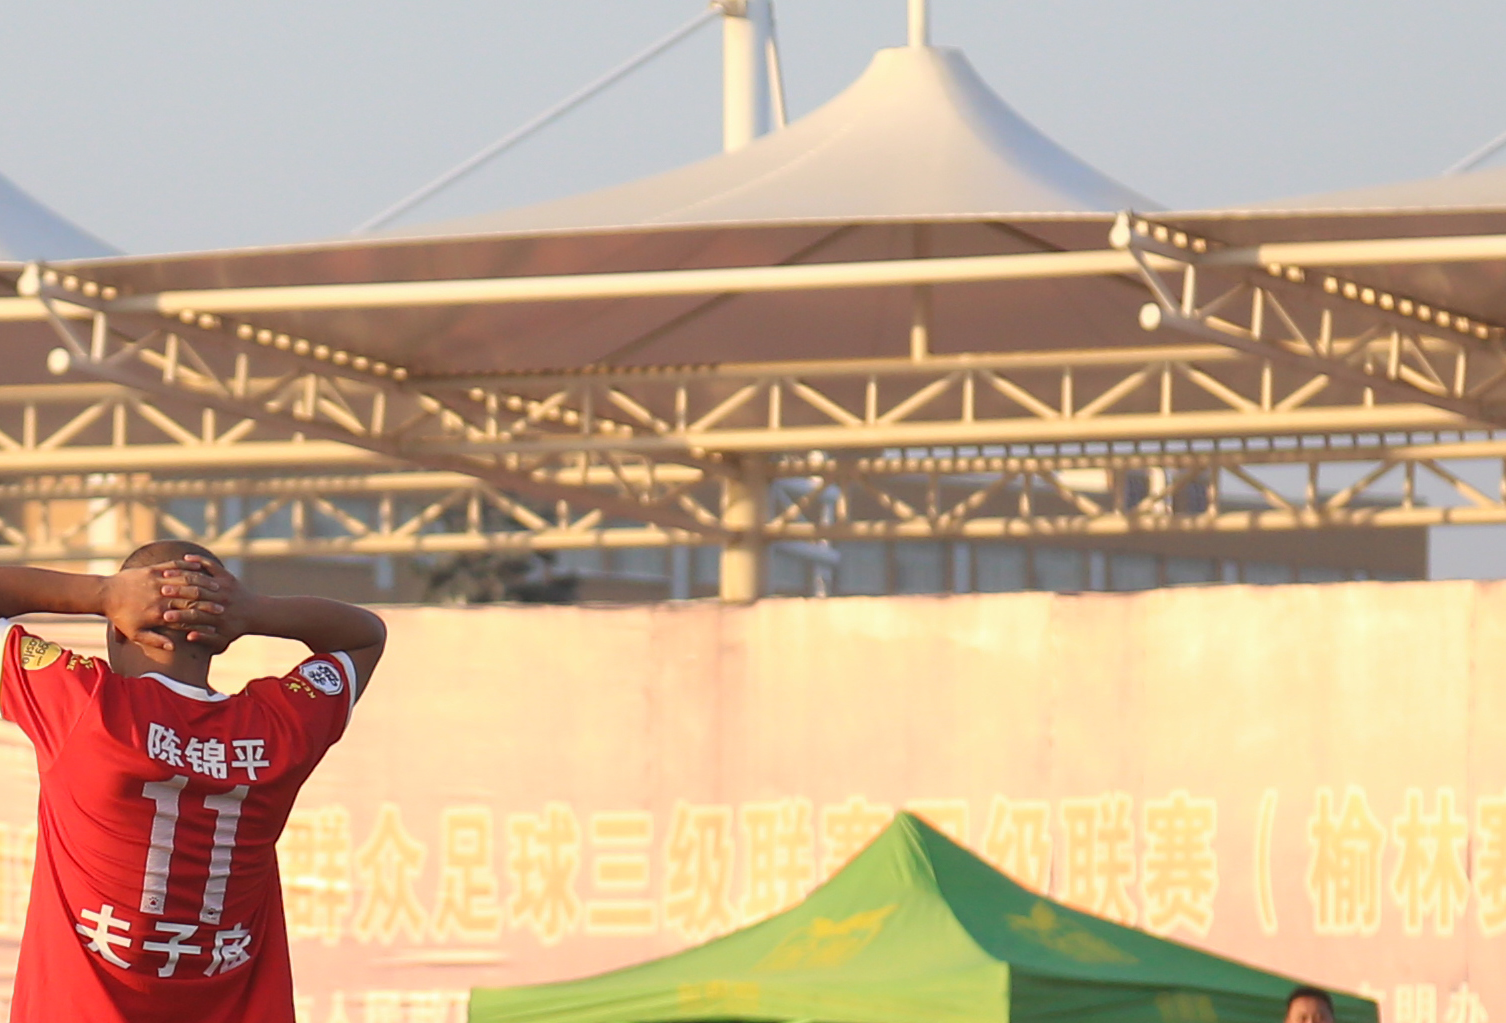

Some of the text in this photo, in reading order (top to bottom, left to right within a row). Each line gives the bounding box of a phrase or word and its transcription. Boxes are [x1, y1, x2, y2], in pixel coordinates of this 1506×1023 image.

[147, 722, 270, 781] 陈锦平
[139, 774, 250, 926] 11
